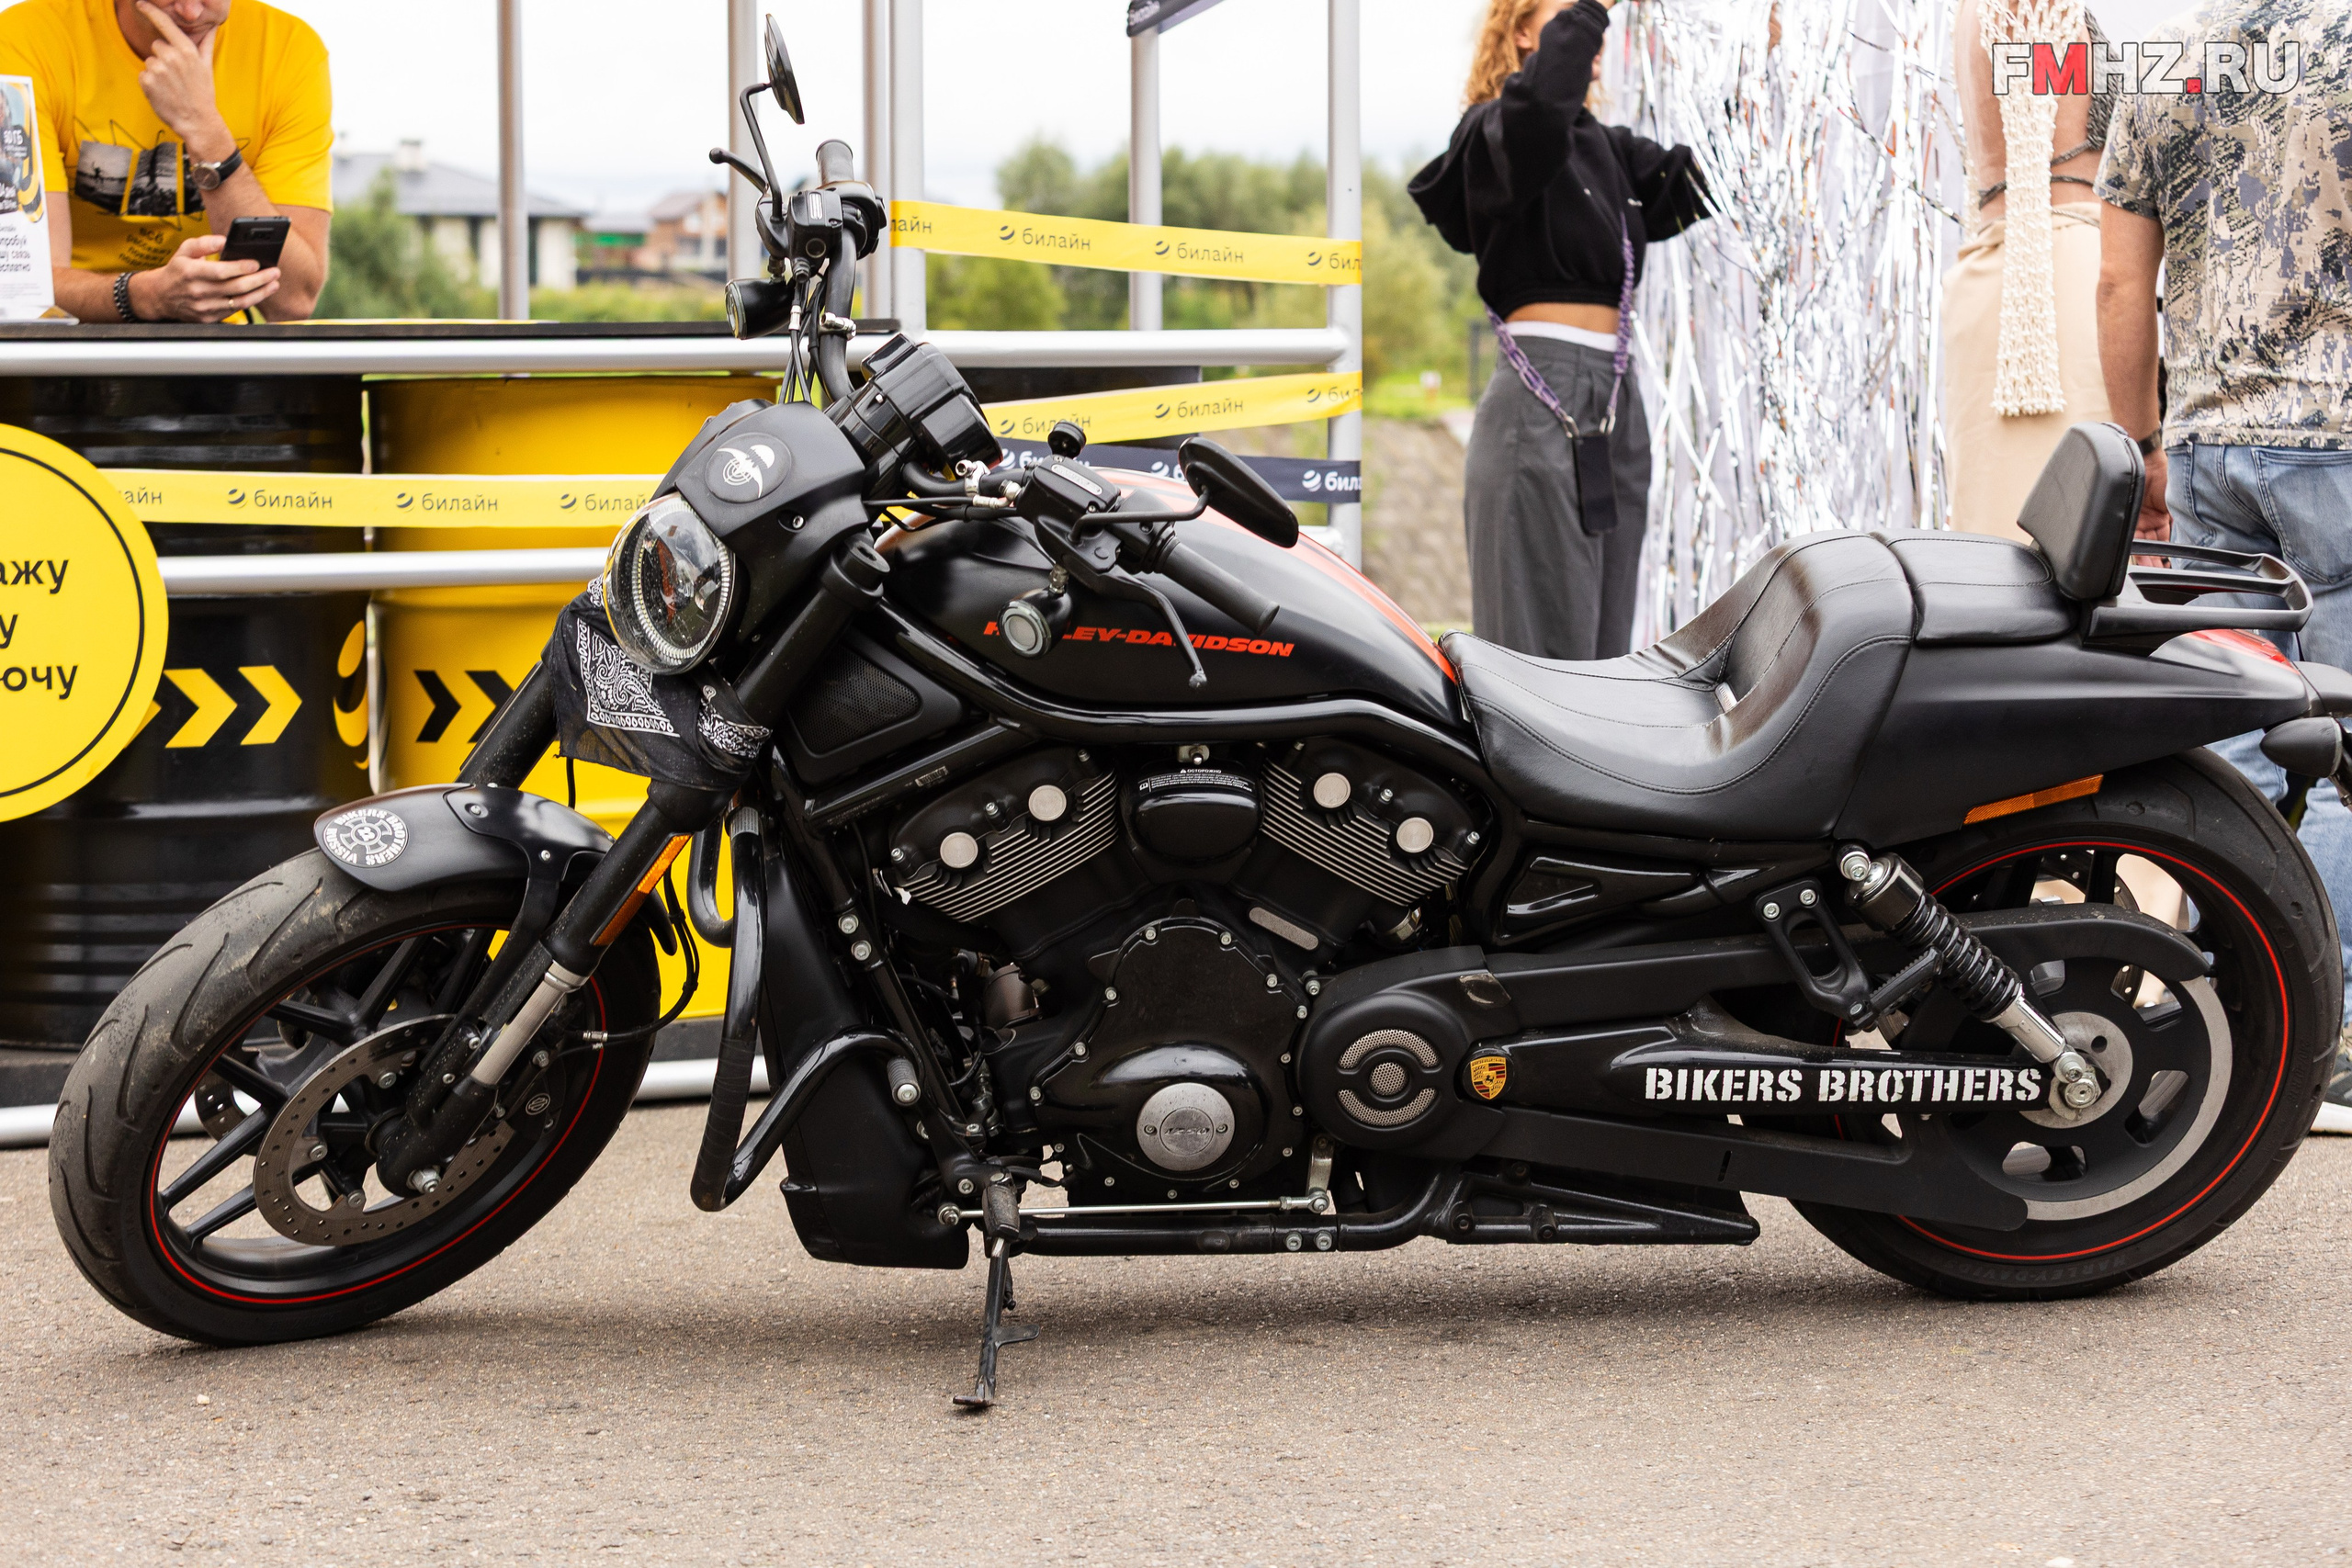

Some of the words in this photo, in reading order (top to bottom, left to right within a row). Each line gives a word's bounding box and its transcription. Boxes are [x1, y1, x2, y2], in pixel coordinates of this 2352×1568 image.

[1022, 227, 1091, 251] билайн
[1177, 243, 1244, 264] билайн
[1177, 398, 1244, 418] билайн
[119, 486, 162, 504] айн
[254, 489, 333, 508] билайн
[422, 492, 499, 511] билайн
[585, 493, 647, 511] билай
[1645, 1067, 1803, 1101] BIKERS
[1818, 1068, 2042, 1102] BROTHERS
